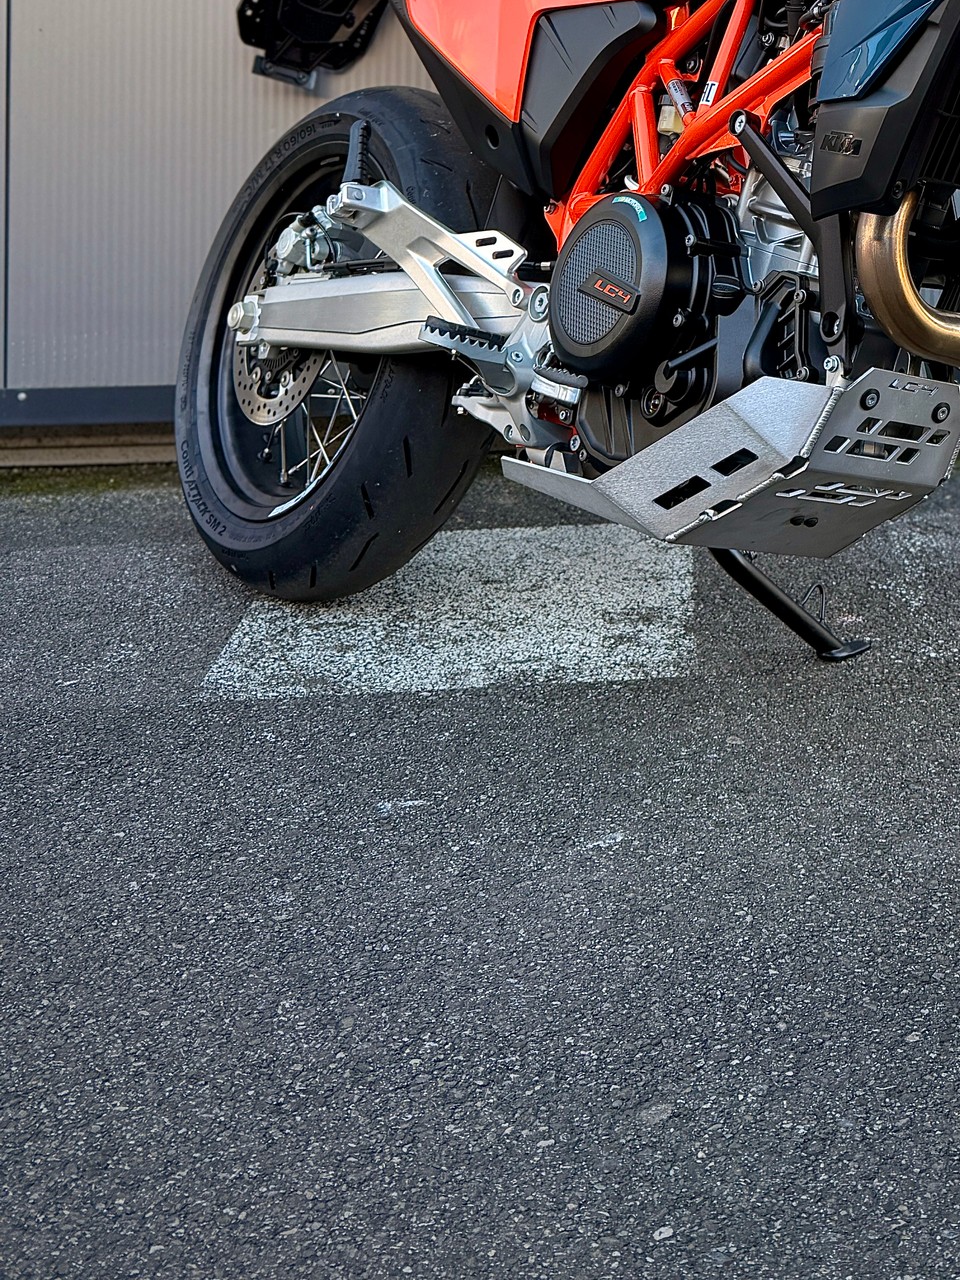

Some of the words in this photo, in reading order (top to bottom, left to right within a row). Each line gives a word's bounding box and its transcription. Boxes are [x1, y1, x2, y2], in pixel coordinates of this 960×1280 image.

[284, 123, 316, 151] 160/60
[820, 130, 863, 156] KTM
[594, 279, 631, 303] LC4
[888, 378, 939, 397] LC4
[217, 524, 228, 537] 2
